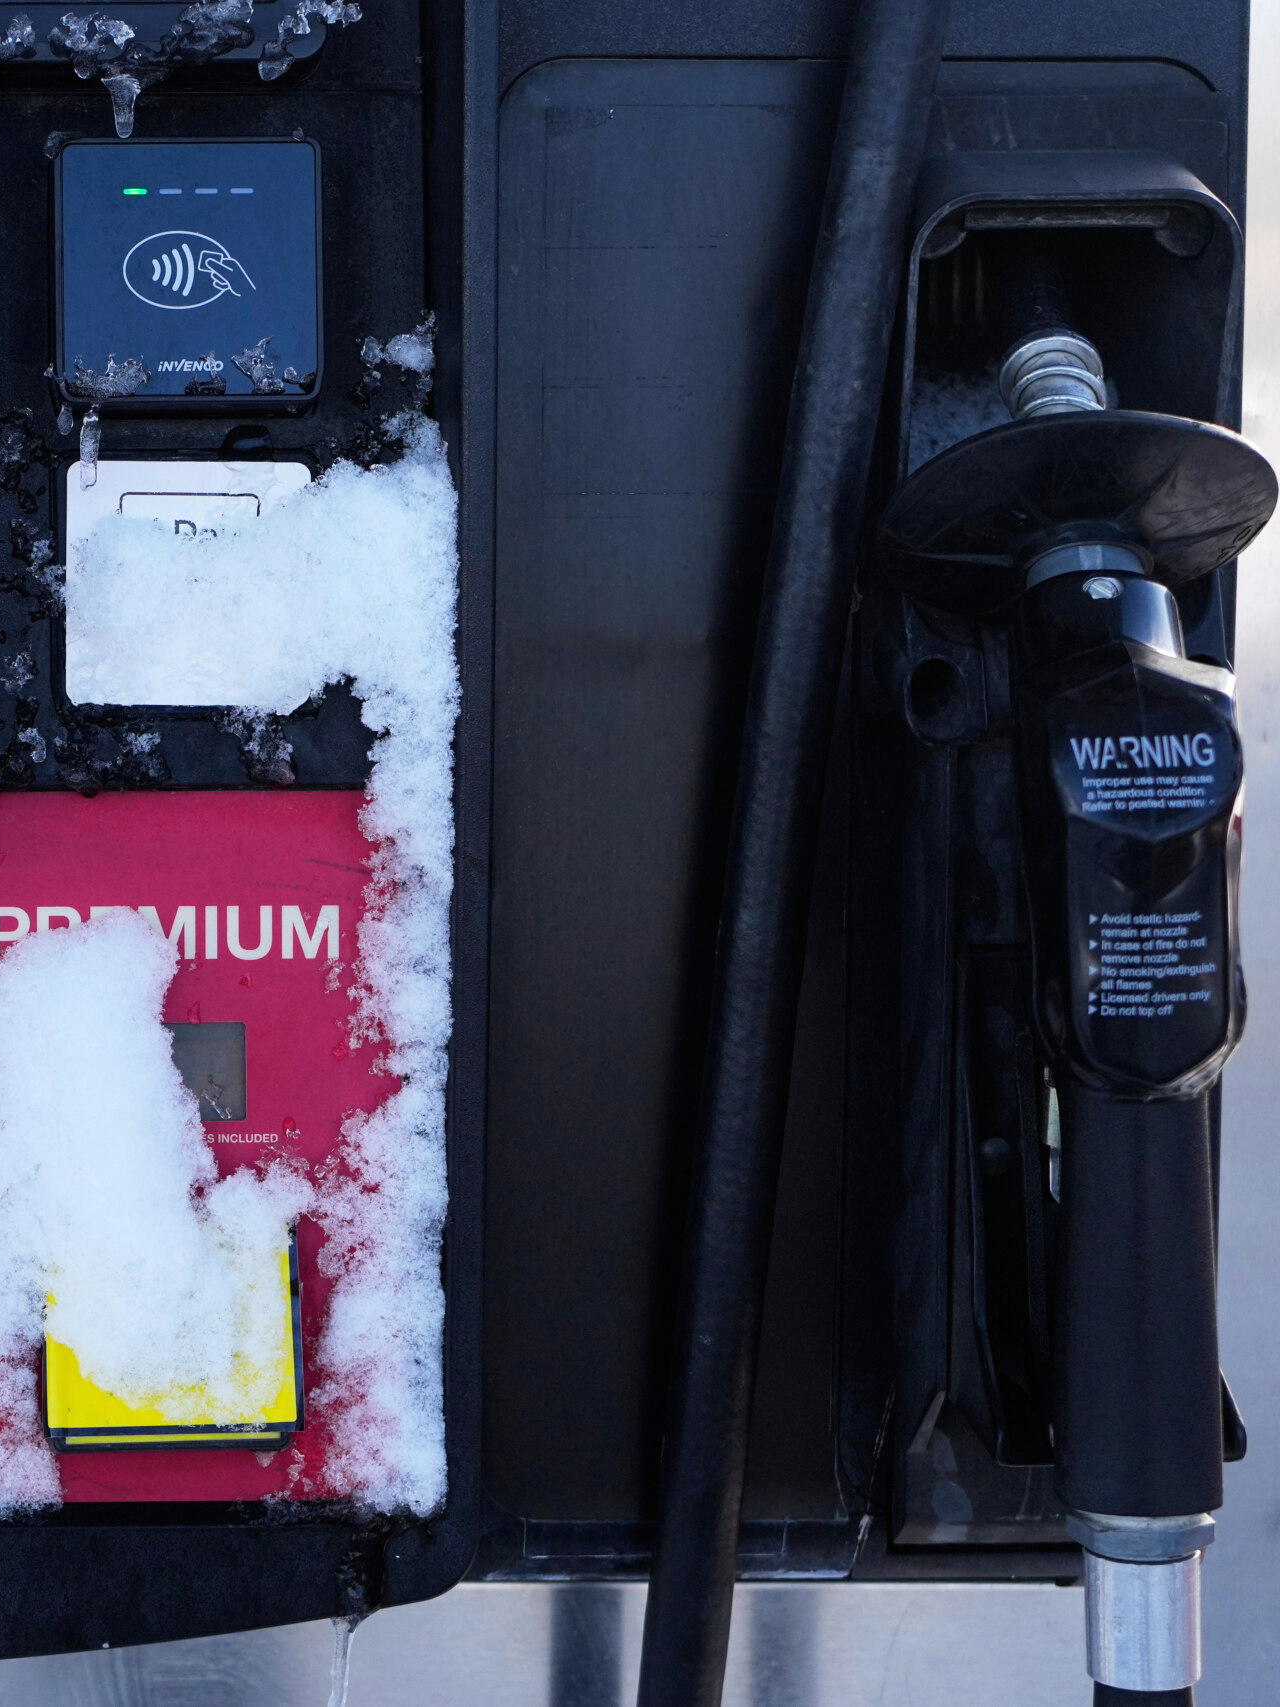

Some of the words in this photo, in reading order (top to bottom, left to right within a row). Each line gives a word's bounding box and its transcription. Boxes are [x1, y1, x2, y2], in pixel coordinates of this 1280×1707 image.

[1070, 733, 1216, 770] WARNING
[1082, 777, 1131, 788] Improper
[1134, 777, 1153, 785] use
[1156, 776, 1178, 787] may
[1180, 775, 1214, 785] cause
[1087, 791, 1095, 800] a
[1097, 788, 1154, 799] hazardous
[1157, 787, 1205, 798] condition
[1082, 801, 1112, 812] Refer
[1114, 800, 1125, 810] to
[1128, 799, 1165, 811] posted
[1101, 913, 1131, 924] Avoid
[1133, 913, 1162, 924] static
[1101, 928, 1137, 937] remain
[1140, 928, 1151, 937] at
[1153, 926, 1188, 937] nozzle
[1101, 940, 1111, 950] In
[1114, 942, 1140, 951] case
[1142, 940, 1153, 950] of
[1155, 939, 1173, 950] fire
[1175, 939, 1188, 949] do
[1190, 937, 1206, 948] not
[1101, 955, 1140, 963] remove
[1143, 952, 1179, 963] nozzle
[1101, 967, 1116, 977] No
[1101, 980, 1113, 990] all
[1116, 979, 1152, 990] flames
[1101, 992, 1149, 1003] Licensed
[1151, 991, 1186, 1002] drivers
[1189, 990, 1210, 1001] only
[1101, 1006, 1116, 1016] Do
[1119, 1006, 1136, 1015] not
[1138, 1006, 1155, 1017] top
[1157, 1004, 1174, 1015] off
[218, 1133, 278, 1143] INCLUDED
